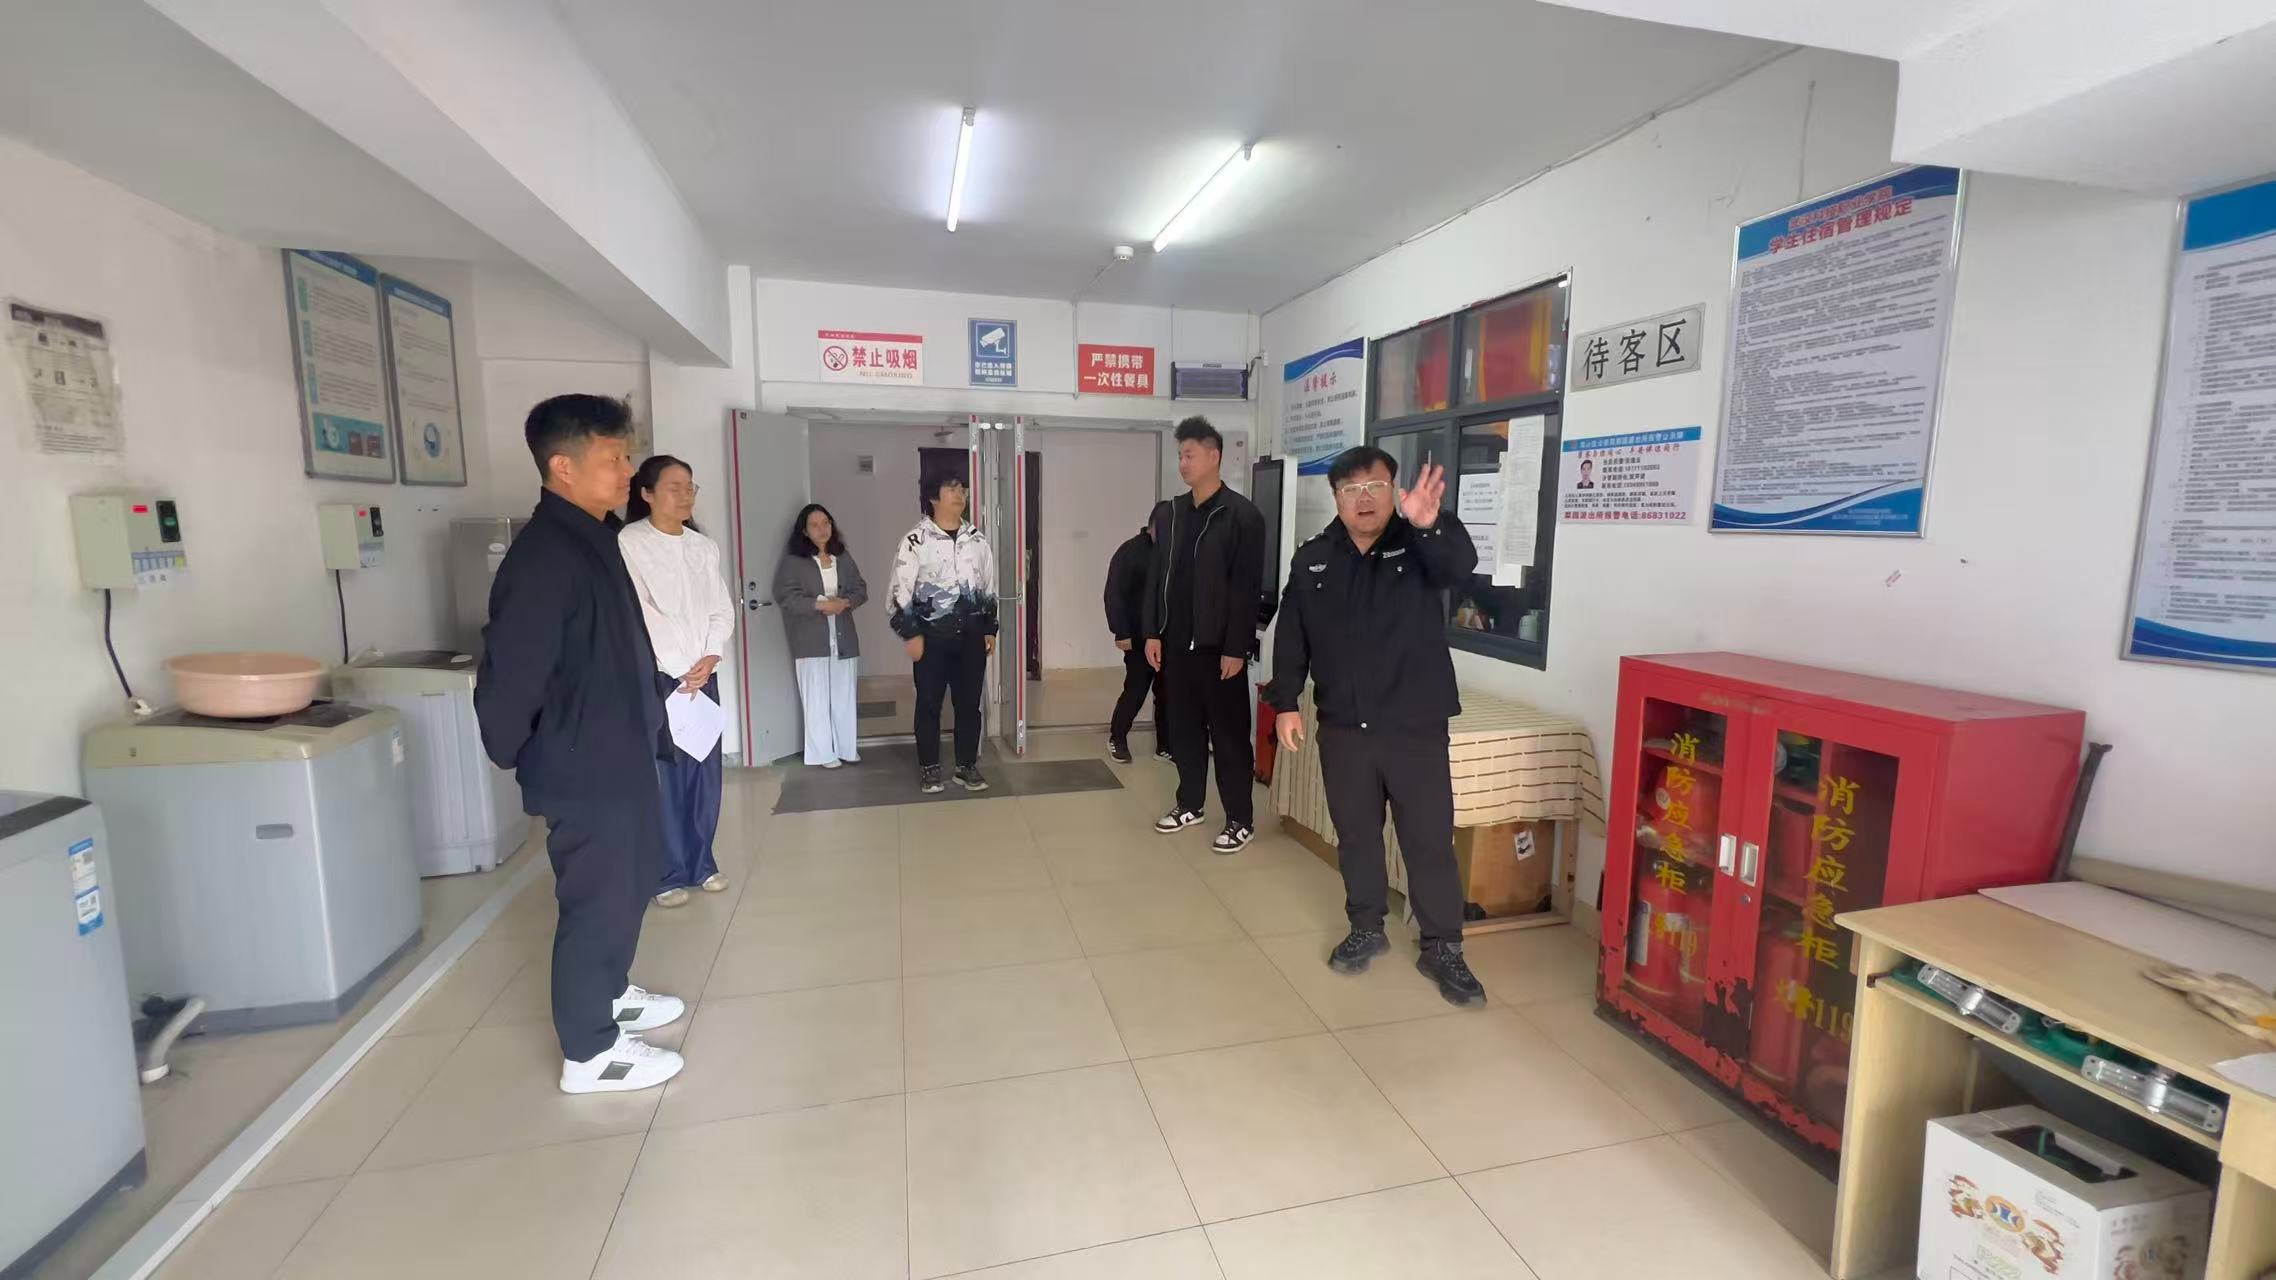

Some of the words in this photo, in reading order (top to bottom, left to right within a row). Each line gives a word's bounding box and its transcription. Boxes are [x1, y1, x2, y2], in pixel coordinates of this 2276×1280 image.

[1770, 197, 1913, 254] 学生住宿管理规定
[852, 345, 918, 369] 禁止吸烟
[1091, 353, 1144, 369] 严禁携带
[1584, 318, 1686, 381] 待客区
[1084, 372, 1149, 388] 一次性餐具
[1655, 732, 1700, 895] 消防应急柜
[1795, 775, 1861, 970] 消防应急柜
